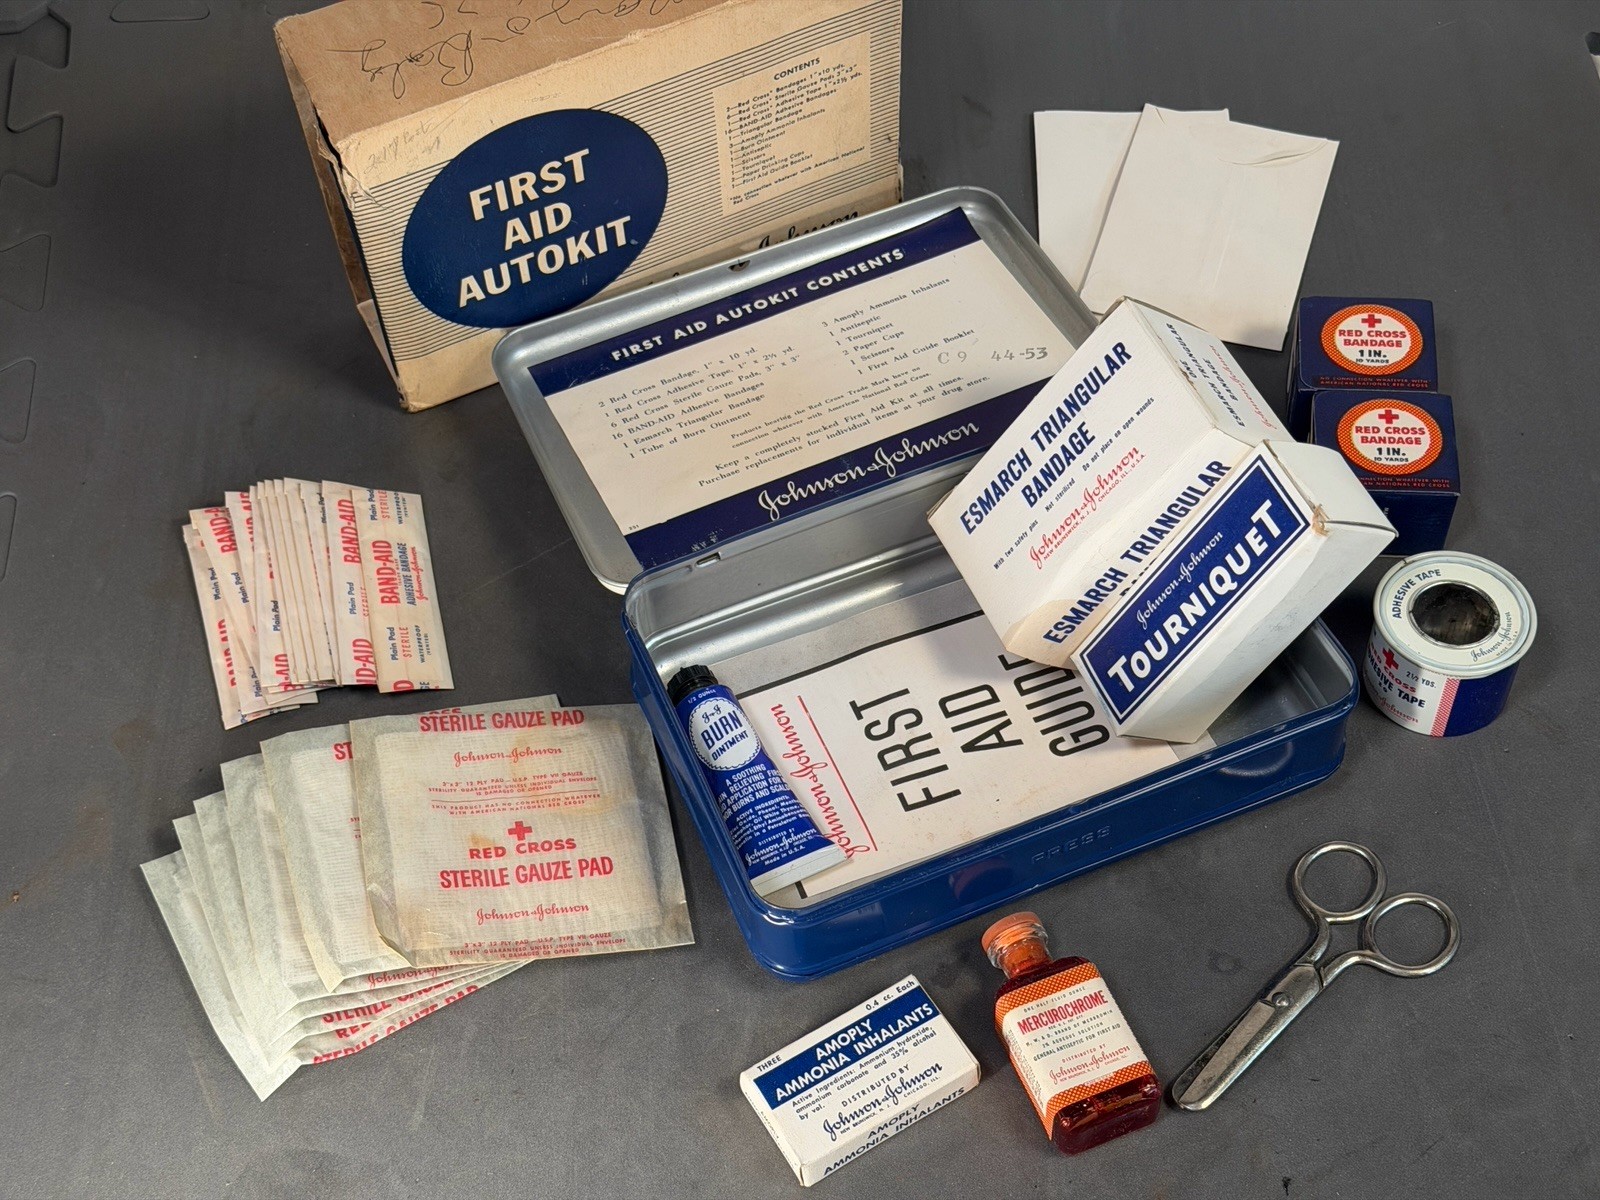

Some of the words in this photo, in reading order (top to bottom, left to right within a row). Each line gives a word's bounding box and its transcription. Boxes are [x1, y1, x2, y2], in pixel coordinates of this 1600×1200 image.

[773, 56, 820, 80] CONTENTS
[469, 148, 590, 221] FIRST
[504, 202, 573, 251] AID
[459, 215, 631, 308] AUTOKIT
[610, 334, 662, 361] FIRST
[674, 320, 707, 340] AID
[715, 286, 798, 324] AUTOKIT
[806, 248, 904, 290] CONTENTS
[833, 309, 864, 323] Amoply
[868, 294, 907, 310] Ammonia
[910, 278, 950, 295] Inhalants
[839, 315, 881, 333] Antiseptic
[844, 322, 894, 342] Tourniquet
[852, 339, 878, 352] Paper
[881, 330, 904, 341] Cups
[1338, 329, 1363, 337] RED
[1367, 330, 1407, 339] CROSS
[859, 346, 895, 362] Scissors
[866, 360, 888, 371] First
[893, 351, 908, 362] Aid
[911, 342, 939, 354] Guide
[942, 328, 975, 343] Booklet
[1343, 339, 1403, 348] BANDAGE
[608, 392, 627, 404] Red
[630, 384, 656, 395] Cross
[659, 369, 700, 385] Bandage,
[666, 378, 705, 396] Adhesive
[707, 368, 734, 379] Tape,
[672, 391, 702, 405] Sterile
[706, 380, 734, 392] Gauze
[737, 371, 762, 382] Pads,
[626, 412, 675, 434] BAND-AID
[680, 398, 719, 415] Adhesive
[722, 381, 764, 399] Bandages
[632, 426, 672, 444] Esmarch
[675, 408, 723, 428] Triangular
[727, 393, 765, 410] Bandage
[714, 459, 739, 470] Keep
[754, 435, 801, 456] completely
[805, 420, 839, 436] stocked
[843, 411, 865, 423] First
[870, 402, 886, 413] Aid
[888, 396, 904, 406] Kit
[937, 376, 964, 388] times.
[638, 443, 664, 454] Tube
[682, 428, 706, 439] Burn
[709, 410, 751, 429] Ointment
[697, 468, 740, 487] Purchase
[744, 445, 803, 470] replacements
[825, 418, 870, 440] individual
[874, 409, 898, 421] items
[916, 395, 935, 407] your
[940, 385, 963, 396] drug
[966, 376, 990, 387] store.
[959, 446, 1032, 535] ESMARCH
[1029, 341, 1132, 452] TRIANGULAR
[1355, 426, 1380, 434] RED
[1384, 426, 1426, 435] CROSS
[1360, 436, 1422, 445] BANDAGE
[1020, 420, 1096, 508] BANDAGE
[377, 490, 391, 519] STERILE
[337, 498, 362, 564] BAND-AID
[397, 543, 411, 573] BANDAGE
[1043, 566, 1129, 644] ESMARCH
[1120, 459, 1232, 566] TRIANGULAR
[346, 582, 355, 595] Pad
[371, 540, 401, 604] BAND-AID
[402, 574, 417, 606] ADHESIVE
[1107, 499, 1282, 693] TOURNIQUET
[1392, 578, 1416, 619] ADHESIVE
[1415, 568, 1442, 582] TAPE
[389, 641, 398, 661] Plain
[398, 626, 412, 658] STERILE
[1397, 688, 1426, 708] TAPE
[419, 712, 487, 732] STERILE
[490, 710, 547, 729] GAUZE
[549, 709, 584, 726] PAD
[700, 710, 743, 750] BURN
[939, 683, 1024, 754] AID
[711, 730, 749, 761] OINTMENT
[849, 687, 962, 813] FIRST
[728, 772, 765, 794] RELIEVING
[731, 763, 767, 782] SOOTHING
[727, 779, 768, 808] APPLICATION
[732, 794, 755, 813] BURNS
[755, 787, 770, 800] AND
[468, 845, 507, 859] RED
[514, 837, 577, 854] CROSS
[439, 866, 510, 888] STERILE
[514, 859, 573, 884] GAUZE
[577, 855, 614, 878] PAD
[864, 998, 879, 1010] 0.4
[895, 980, 915, 993] Each
[1016, 989, 1108, 1035] MERCUROCHROME
[775, 1052, 851, 1101] AMMONIA
[852, 1002, 933, 1055] INHALANTS
[815, 1018, 872, 1061] AMOPLY
[756, 1054, 782, 1072] THREE
[791, 1092, 813, 1107] Active
[814, 1068, 855, 1094] Ingredients:
[858, 1045, 895, 1069] Ammonium
[895, 1026, 933, 1048] hydroxide,
[795, 1090, 832, 1114] ammonium
[836, 1069, 869, 1091] carbonate
[873, 1057, 887, 1069] and
[912, 1029, 937, 1047] alcohol
[840, 1071, 897, 1107] DISTRIBUTED
[897, 1063, 909, 1074] BY
[798, 1112, 808, 1120] by
[810, 1103, 825, 1113] vol.
[866, 1103, 919, 1139] AMOPLY
[823, 1132, 893, 1176] AMMONIA
[895, 1086, 969, 1132] INHALANTS
